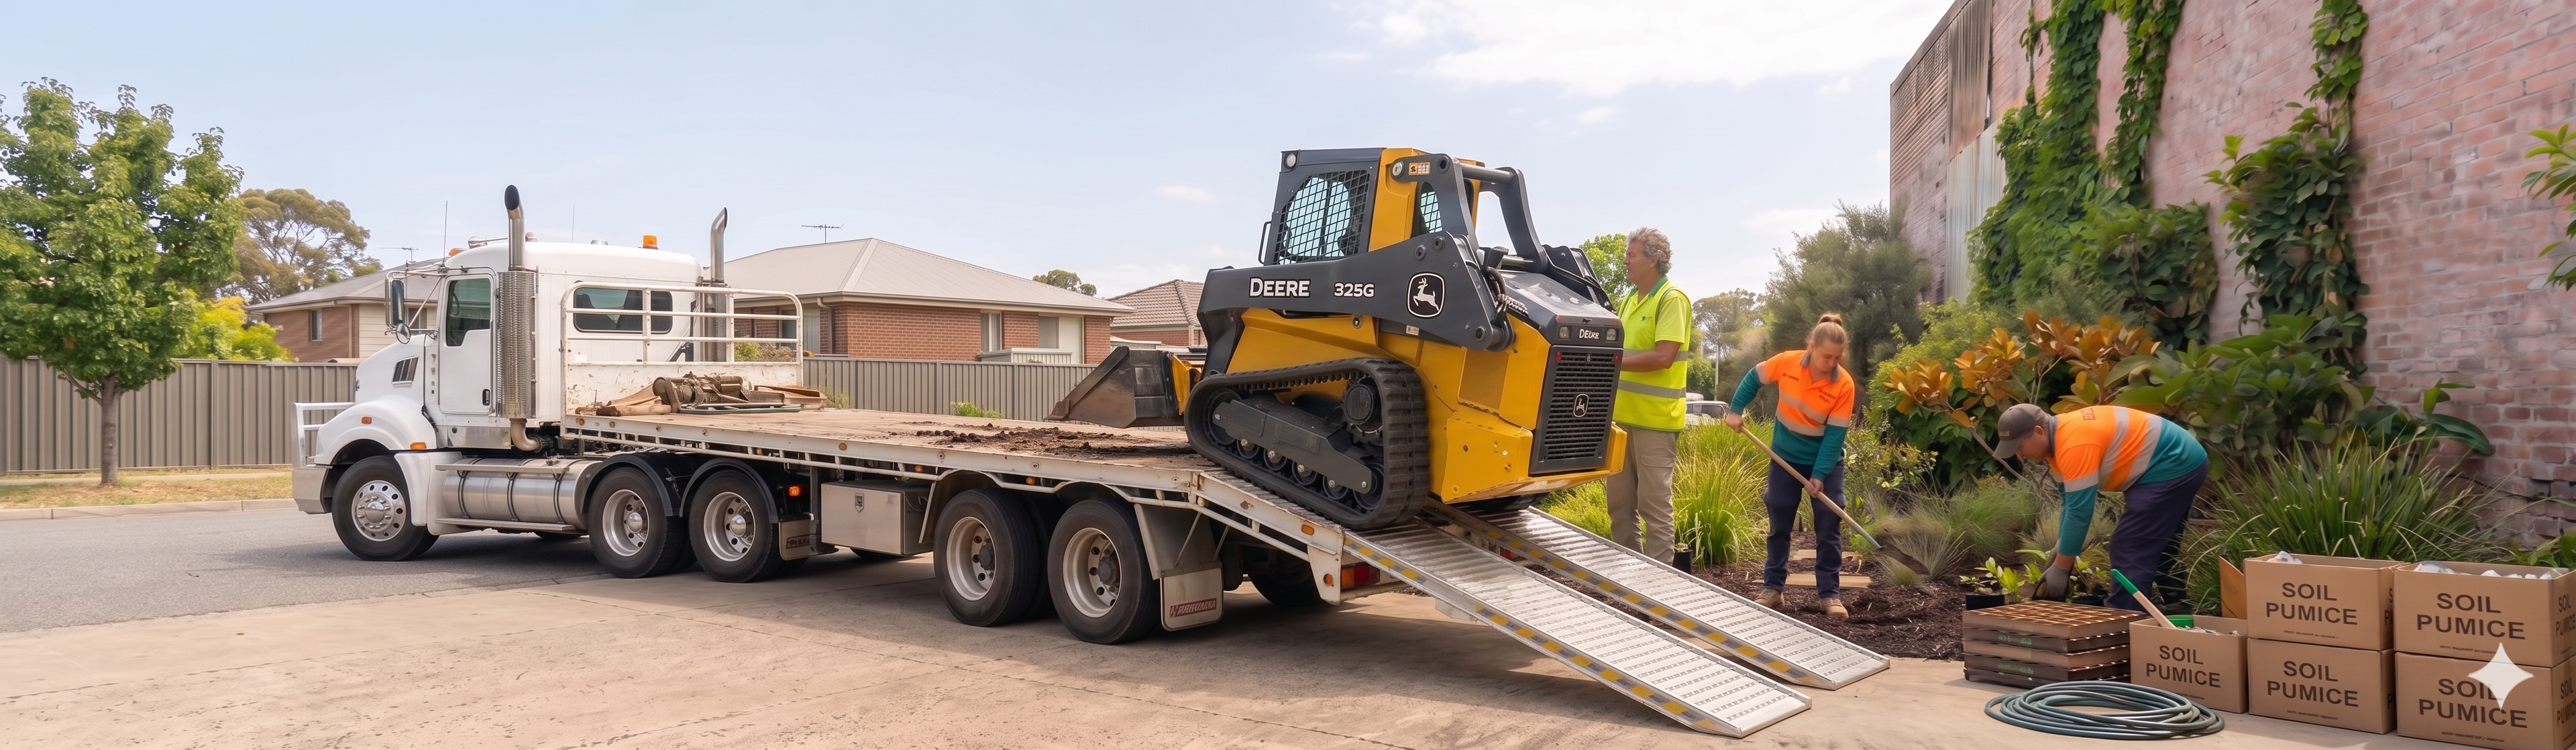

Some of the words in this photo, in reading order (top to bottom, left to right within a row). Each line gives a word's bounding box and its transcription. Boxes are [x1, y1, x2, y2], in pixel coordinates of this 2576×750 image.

[1250, 278, 1310, 297] DEERE
[1334, 283, 1375, 297] 325G
[2282, 582, 2337, 601] SOIL
[2266, 602, 2357, 625] PUMICE
[2436, 593, 2502, 613] SOIL
[2417, 614, 2526, 640] PUMICE
[2159, 645, 2204, 665] SOIL
[2146, 663, 2221, 688] PUMICE
[2284, 661, 2339, 682] SOIL
[2267, 680, 2359, 708] PUMICE
[2419, 698, 2528, 729] PUMICE
